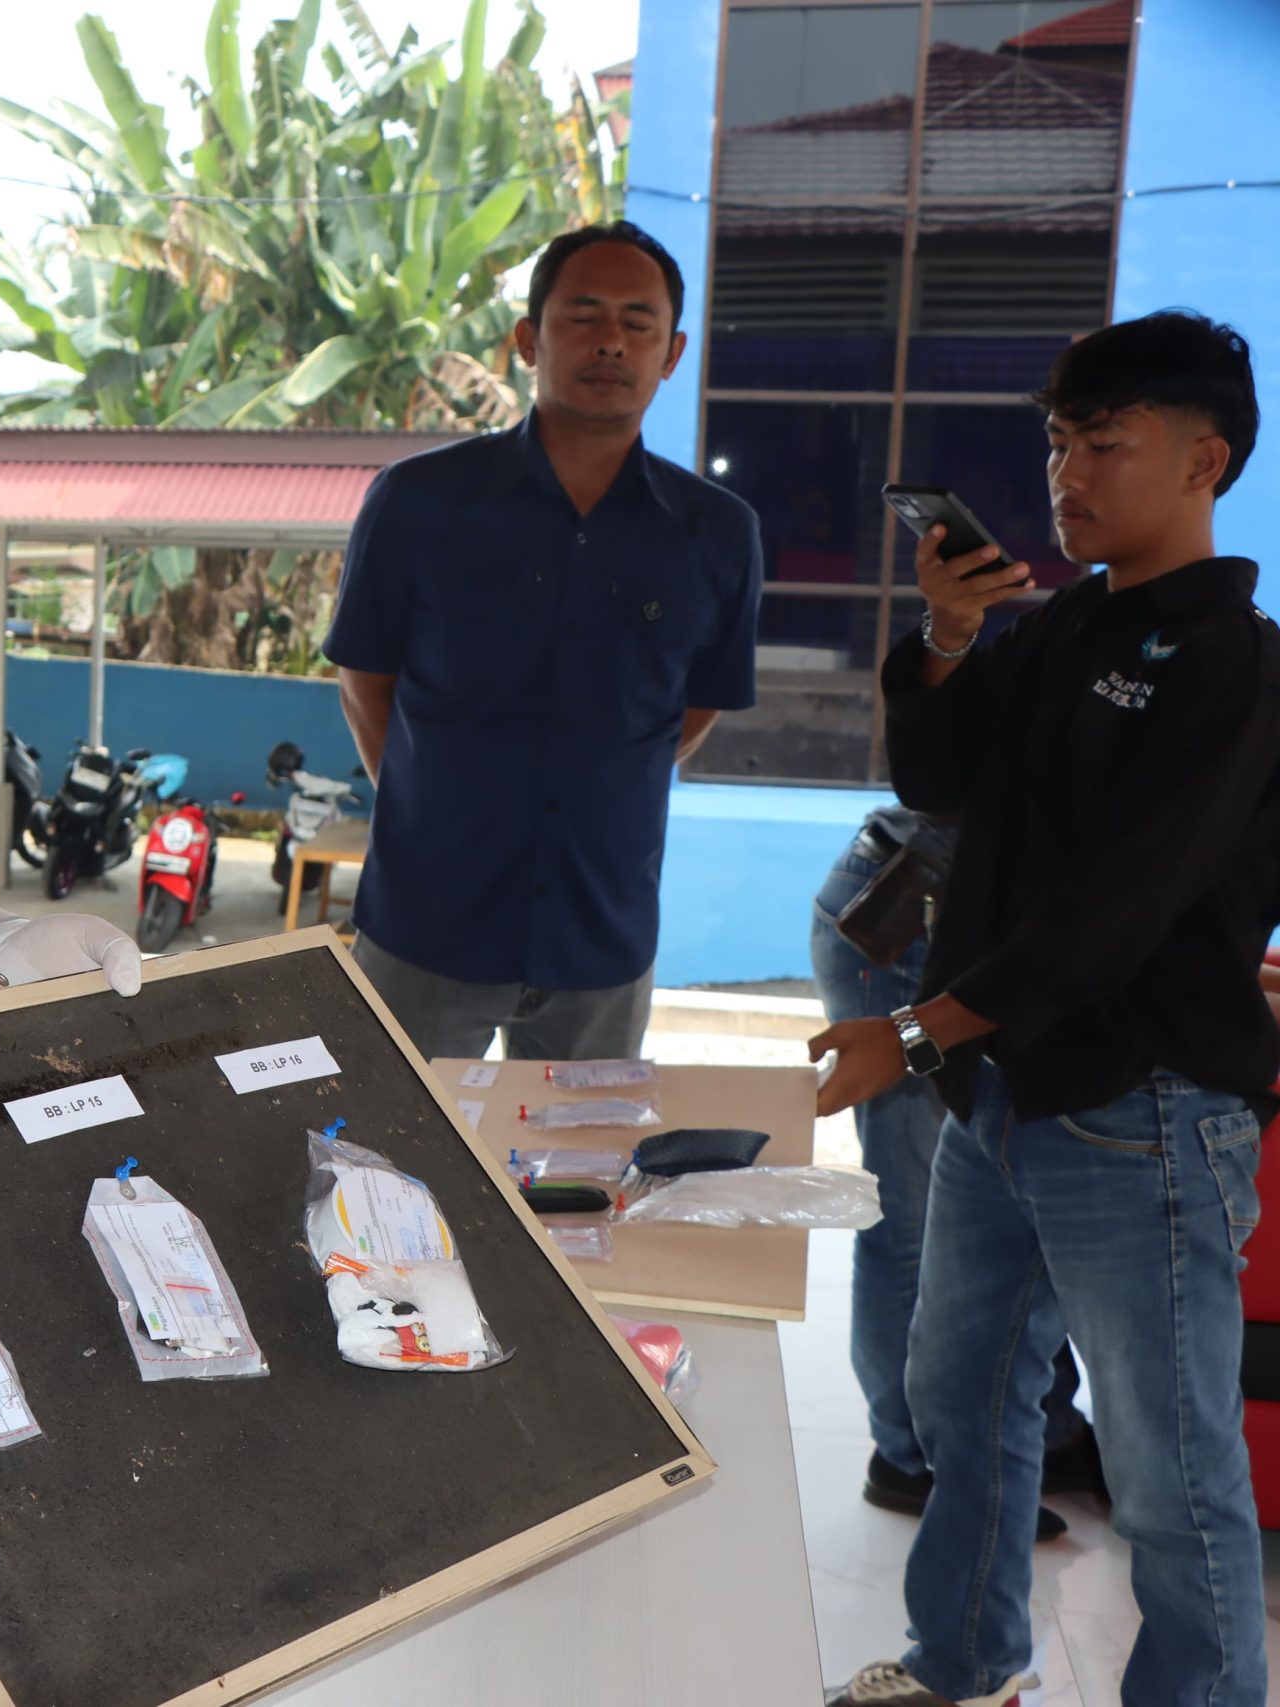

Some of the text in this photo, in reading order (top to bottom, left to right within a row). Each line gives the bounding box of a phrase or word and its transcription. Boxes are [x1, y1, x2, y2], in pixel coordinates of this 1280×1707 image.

[249, 1061, 268, 1073] BB
[273, 1057, 287, 1069] LP
[289, 1054, 303, 1066] 16
[43, 1105, 63, 1118] BB
[70, 1099, 85, 1112] LP
[87, 1095, 103, 1108] 15
[151, 1296, 169, 1332] Pegadaian
